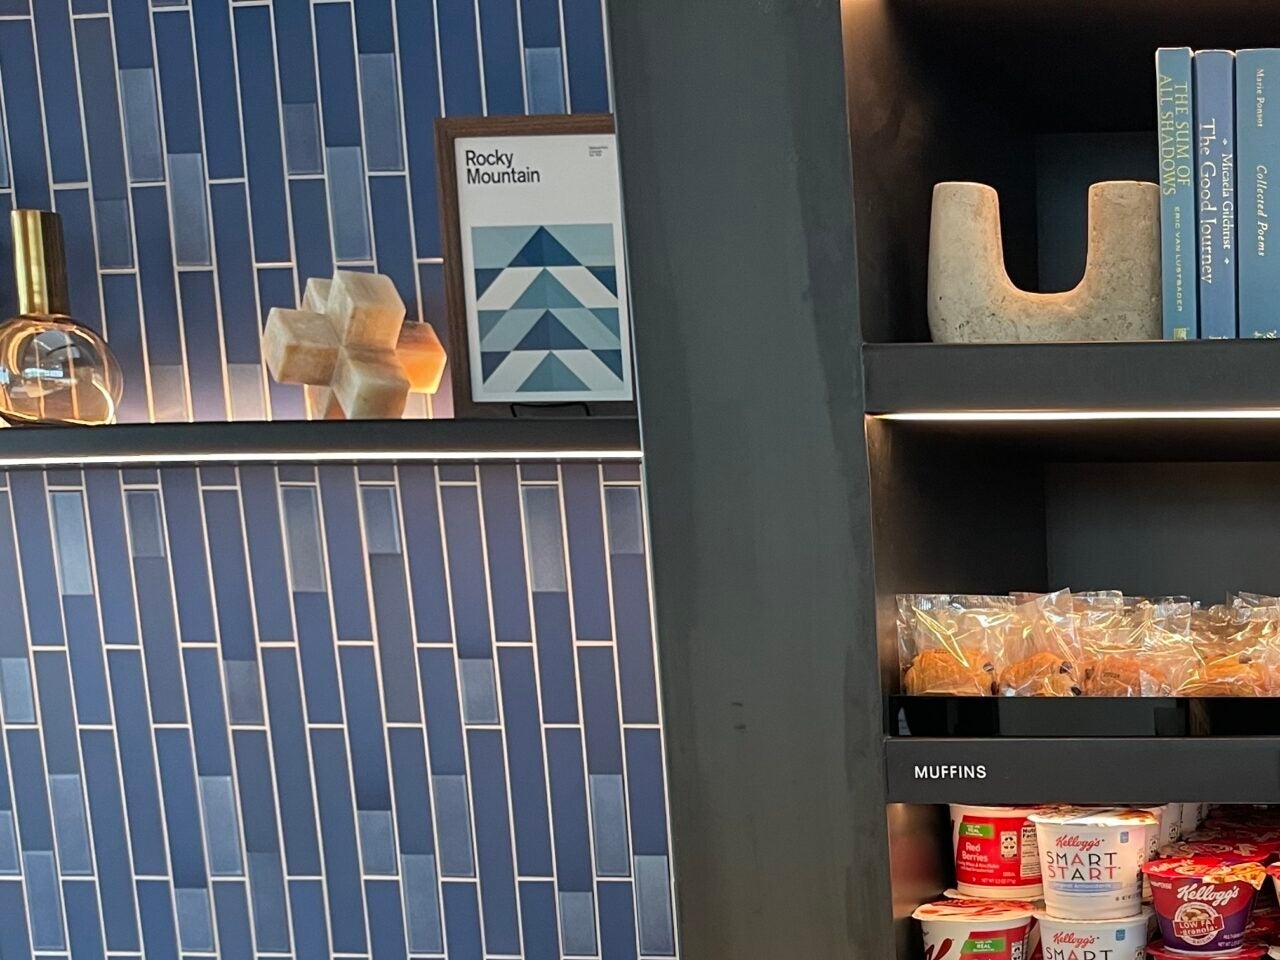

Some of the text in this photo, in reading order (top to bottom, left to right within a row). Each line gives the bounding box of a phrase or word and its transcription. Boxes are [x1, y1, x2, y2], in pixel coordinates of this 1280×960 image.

[1160, 74, 1176, 196] ALL SHADOWS
[1174, 80, 1191, 188] THE SUM OF
[465, 149, 514, 169] Rocky
[466, 166, 541, 185] Mountain
[1200, 117, 1217, 284] The Good Journey
[1256, 164, 1268, 257] Collected Poems
[914, 765, 987, 780] MUFFINS
[1055, 834, 1101, 851] Kellogg's
[1047, 851, 1118, 866] SMART
[1048, 865, 1118, 881] START
[1176, 883, 1240, 906] Kellogg's
[1179, 921, 1198, 929] LOW
[1182, 925, 1215, 936] granola
